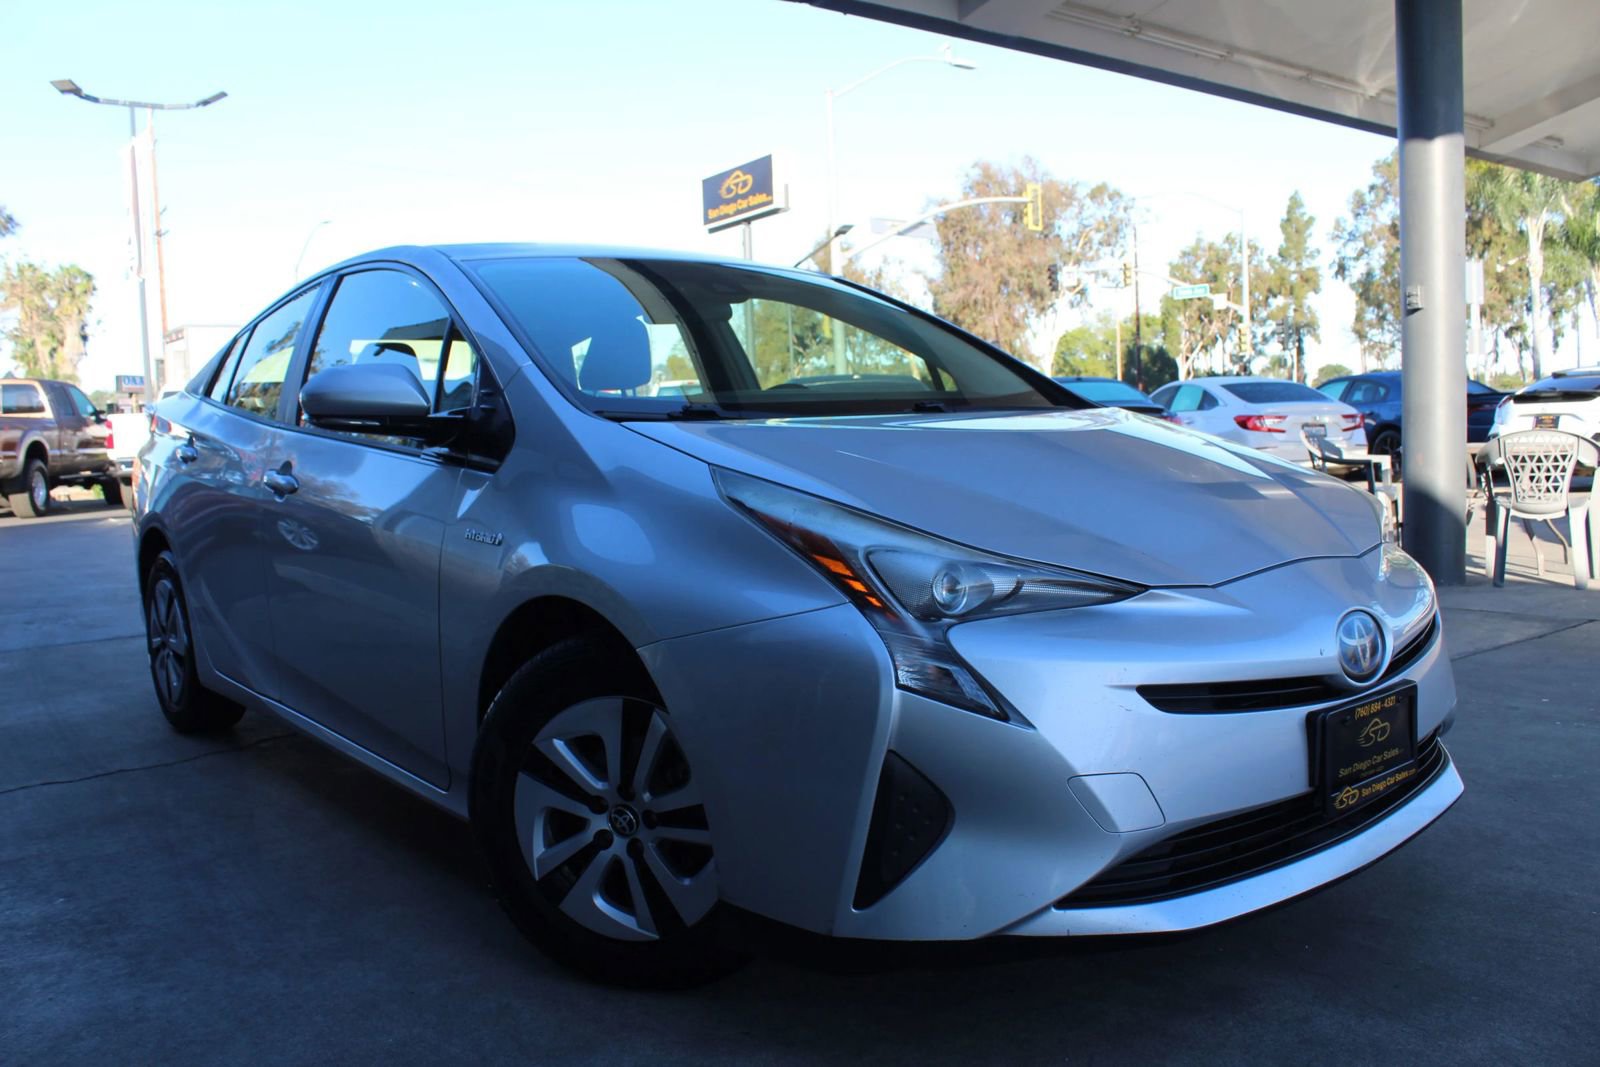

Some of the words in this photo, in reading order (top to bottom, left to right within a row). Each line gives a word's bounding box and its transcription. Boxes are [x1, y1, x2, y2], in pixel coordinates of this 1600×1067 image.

[1338, 767, 1352, 778] San
[1353, 760, 1371, 771] Diego
[1372, 754, 1383, 764] Car
[1383, 747, 1399, 759] Sales
[1361, 787, 1372, 797] San
[1372, 780, 1387, 793] Diego
[1386, 776, 1396, 786] Car
